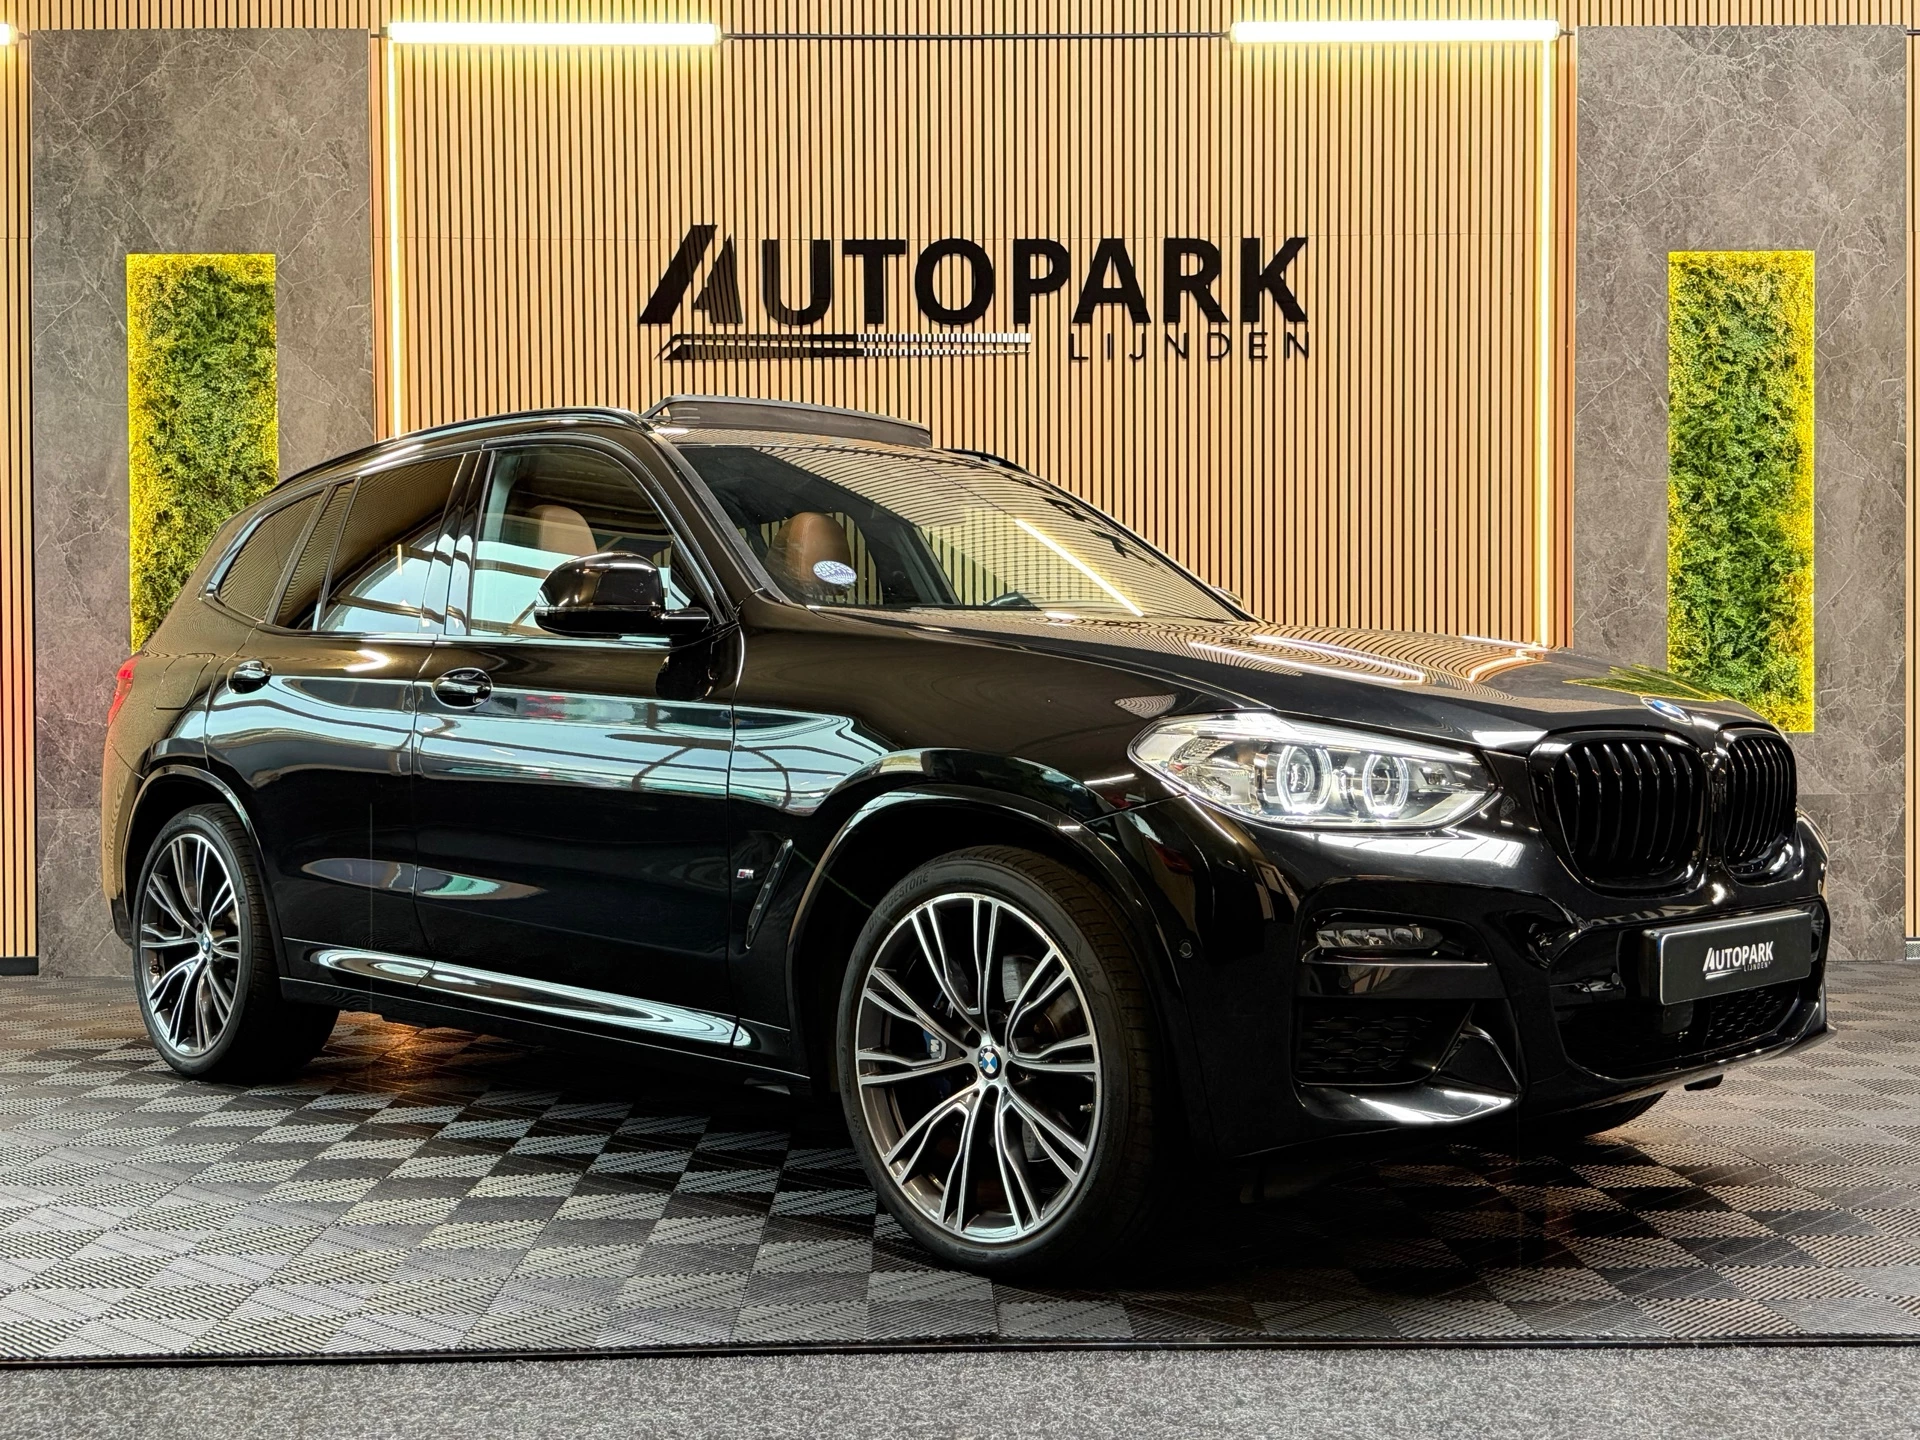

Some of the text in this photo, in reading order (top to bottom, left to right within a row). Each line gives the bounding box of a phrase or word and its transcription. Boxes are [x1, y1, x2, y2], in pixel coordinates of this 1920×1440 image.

[638, 224, 1309, 326] AUTOPARK
[1070, 331, 1310, 363] LIJNDEN
[1703, 941, 1774, 971] AUTOPARK
